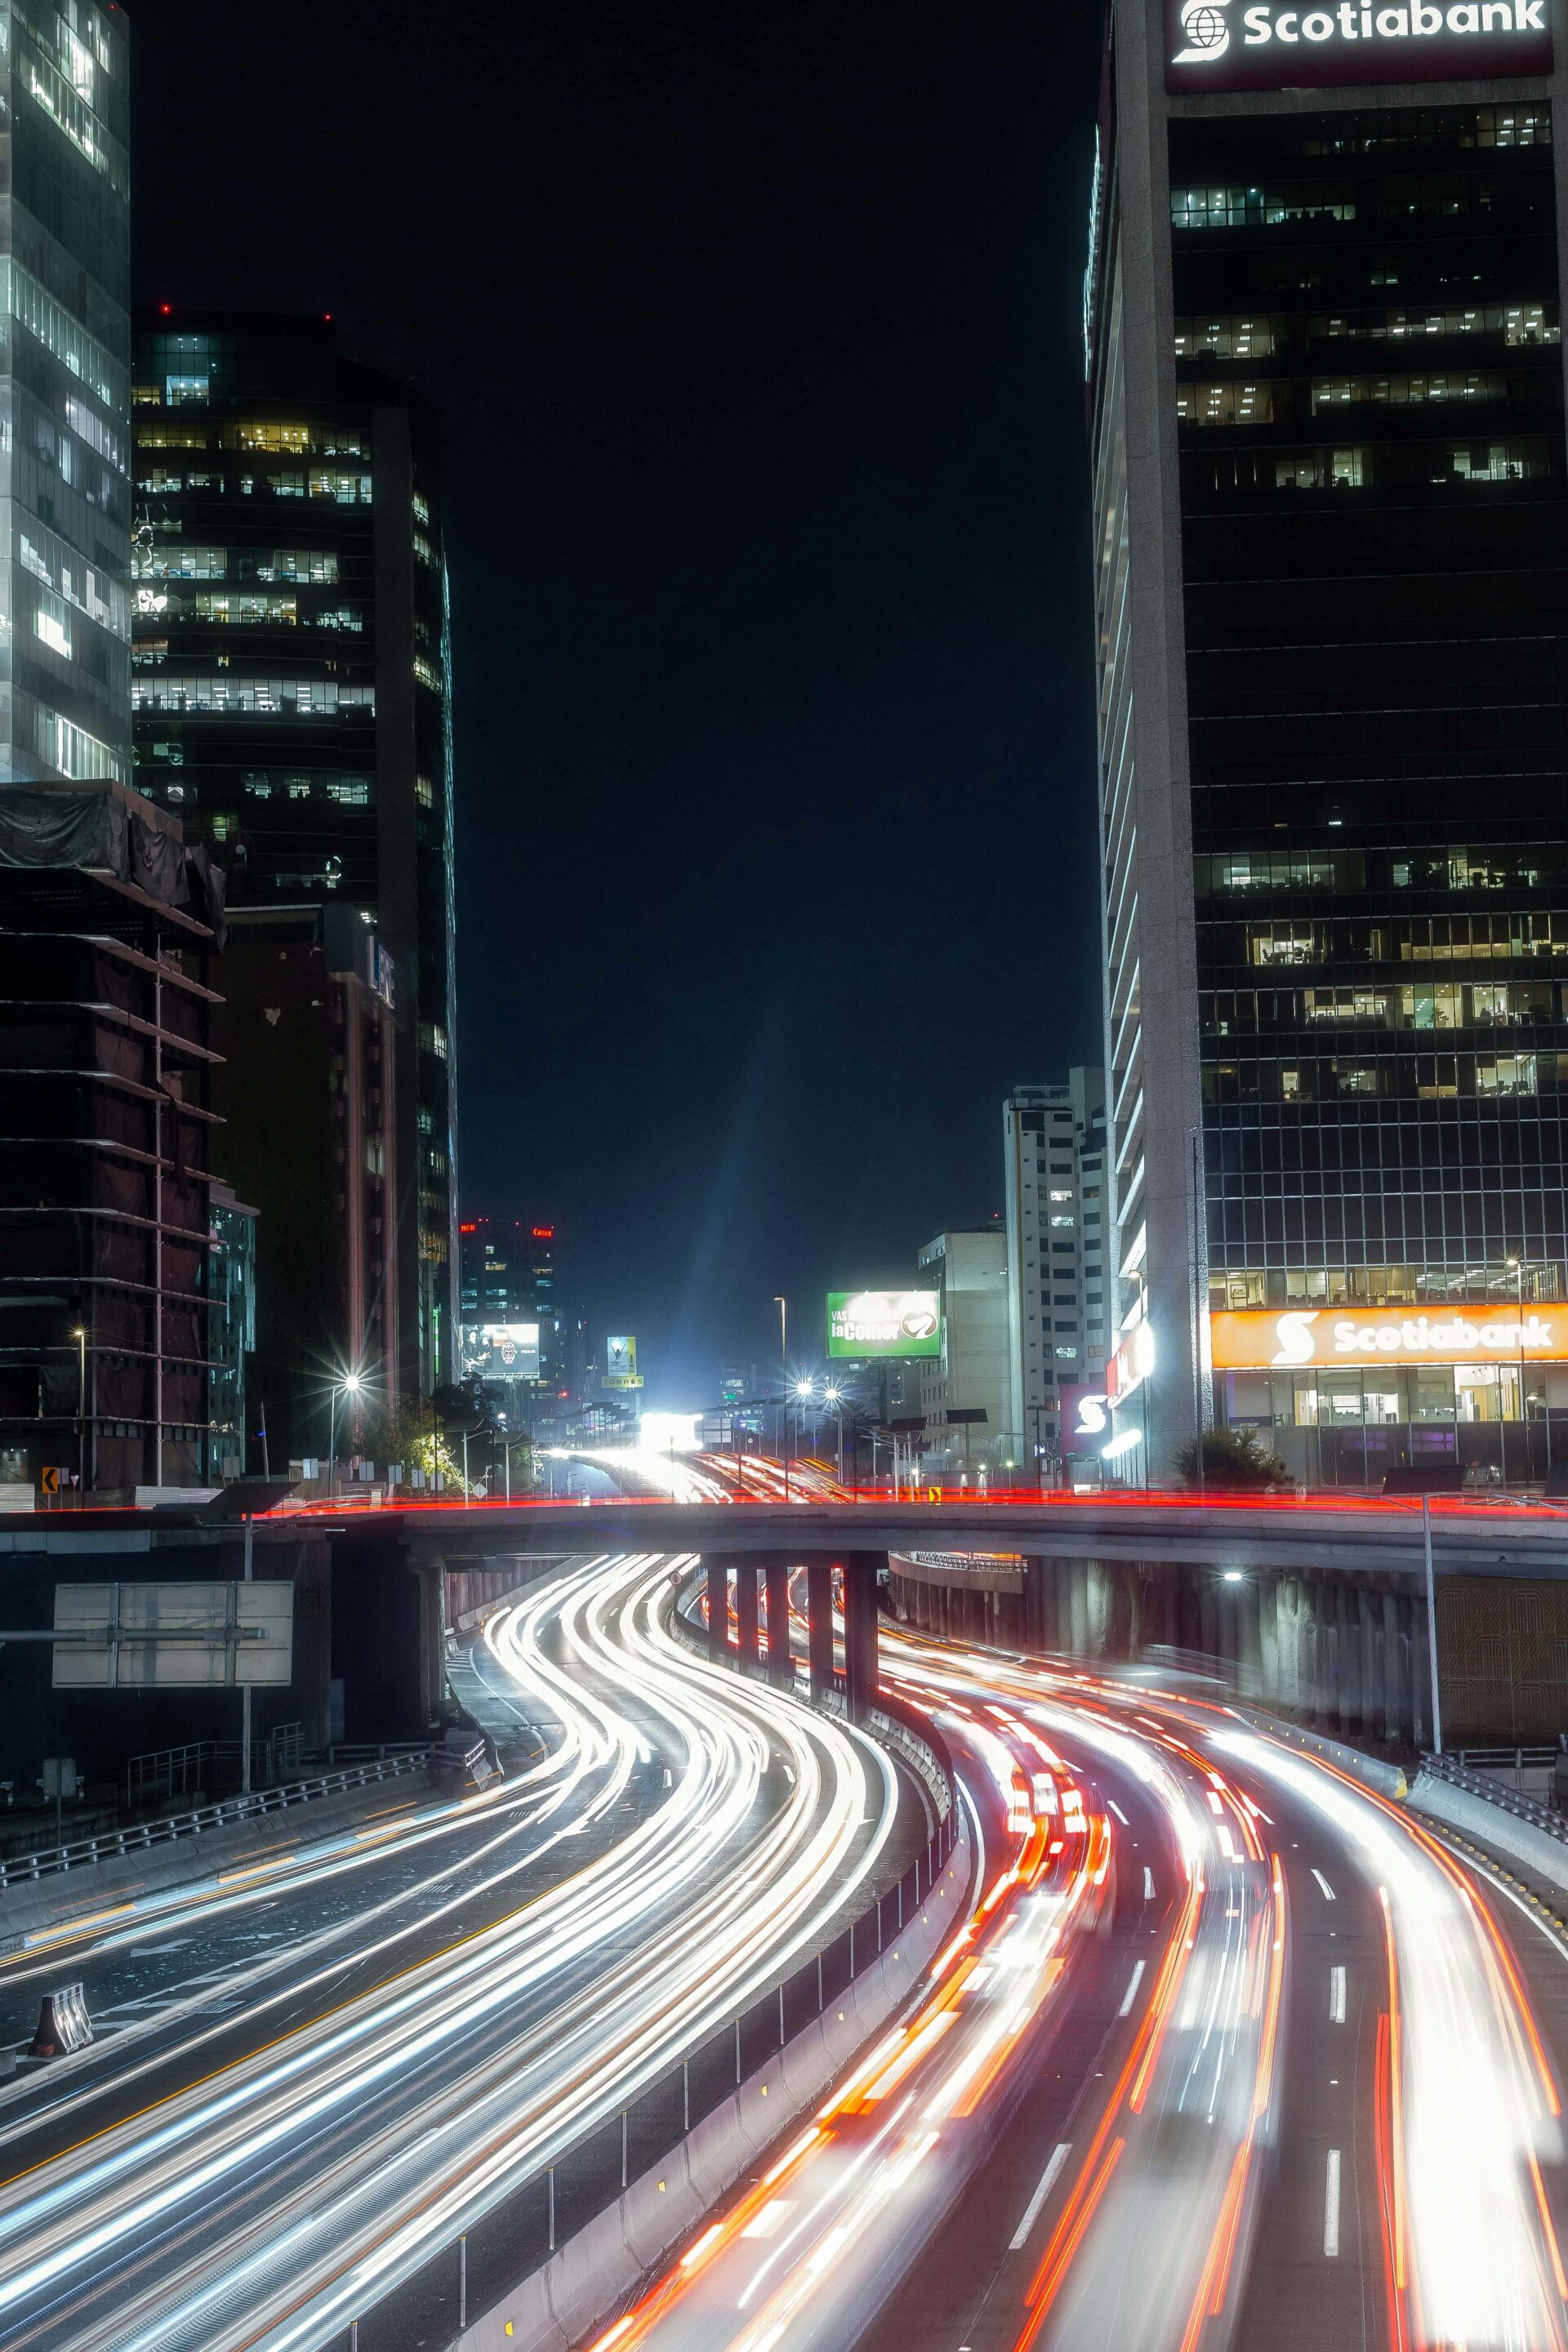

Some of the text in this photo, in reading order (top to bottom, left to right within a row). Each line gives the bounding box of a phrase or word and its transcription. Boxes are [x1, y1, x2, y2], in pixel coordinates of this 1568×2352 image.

[1242, 0, 1545, 45] Scotiabank
[532, 1227, 553, 1237] Canon
[1334, 1316, 1552, 1352] Scotiabank
